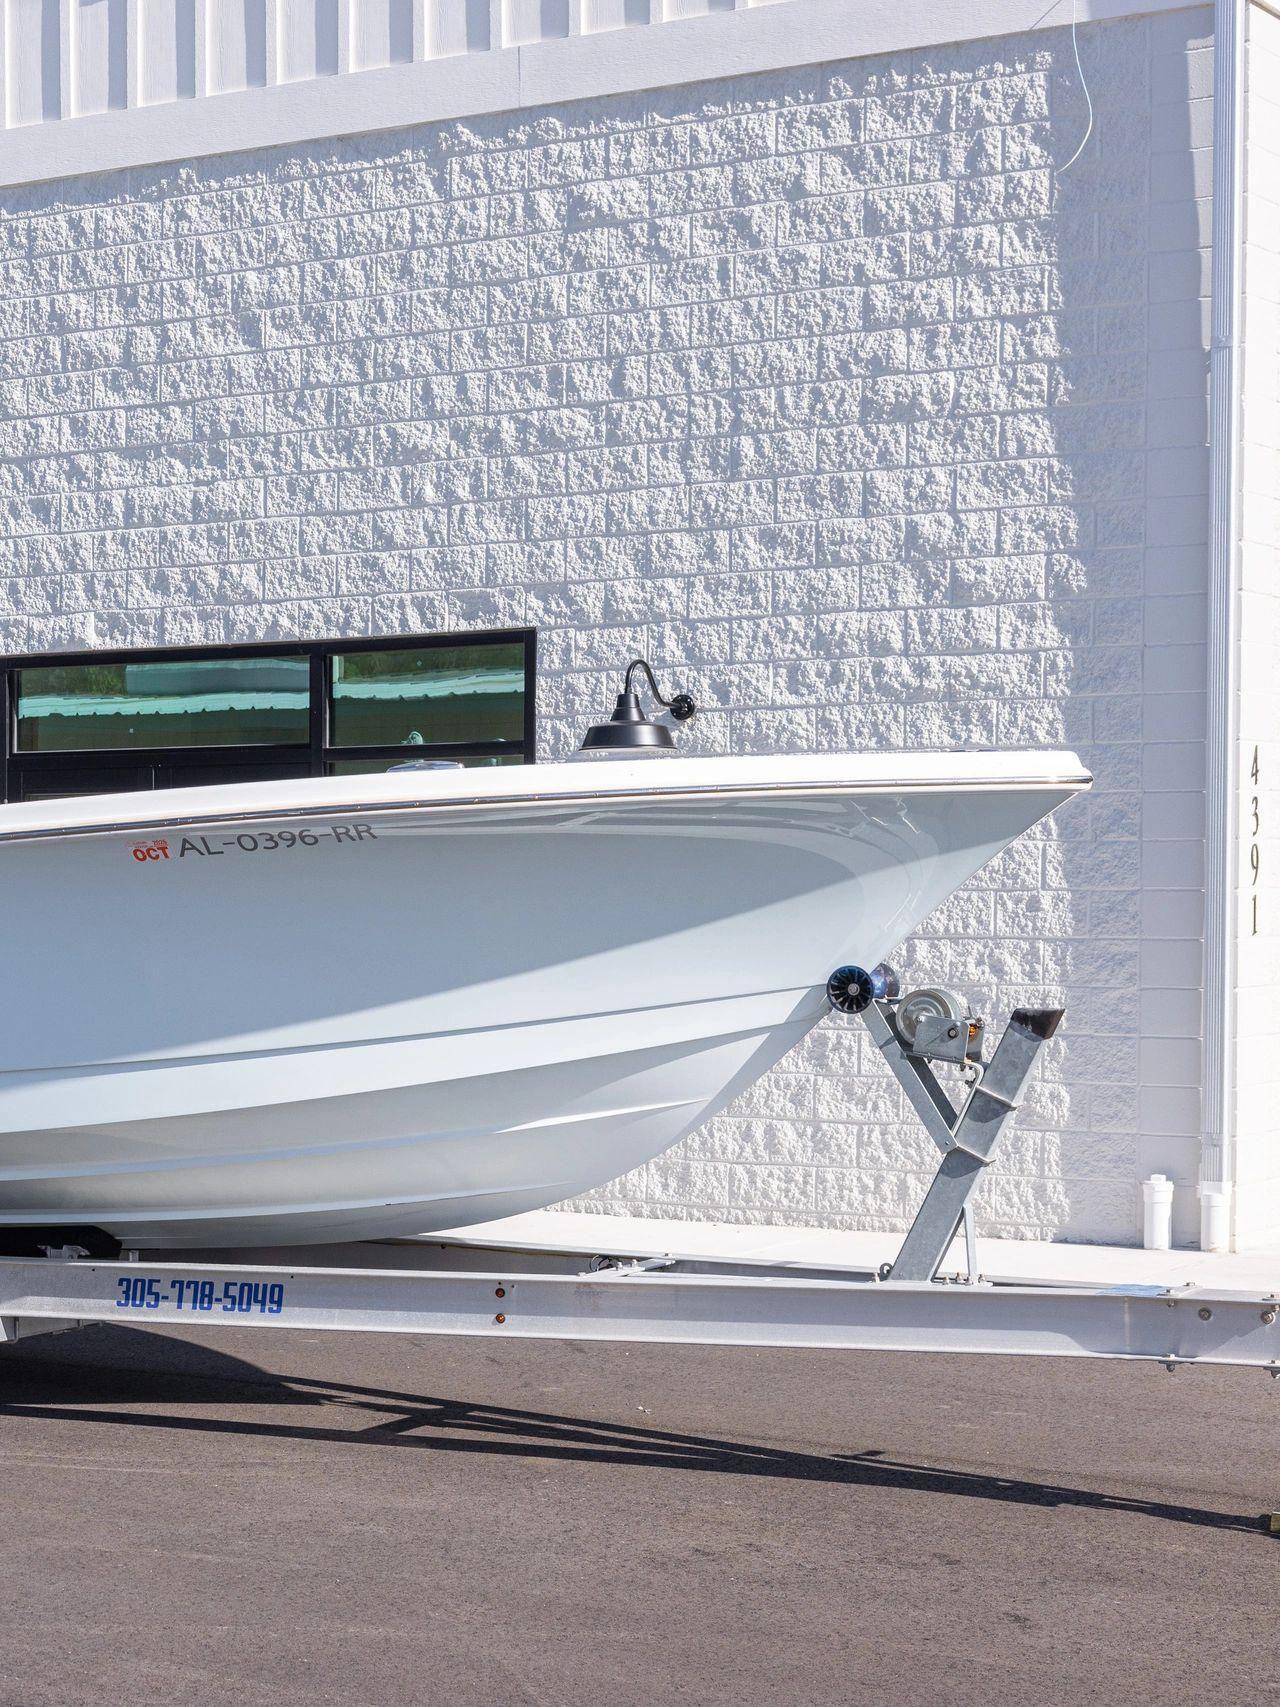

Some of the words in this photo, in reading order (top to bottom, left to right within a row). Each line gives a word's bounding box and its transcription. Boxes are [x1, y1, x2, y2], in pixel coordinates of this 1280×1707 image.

[132, 846, 170, 861] OCT
[179, 824, 378, 857] AL-0396-RR
[1250, 745, 1260, 936] 4391
[116, 1277, 284, 1313] 305-778-5049
